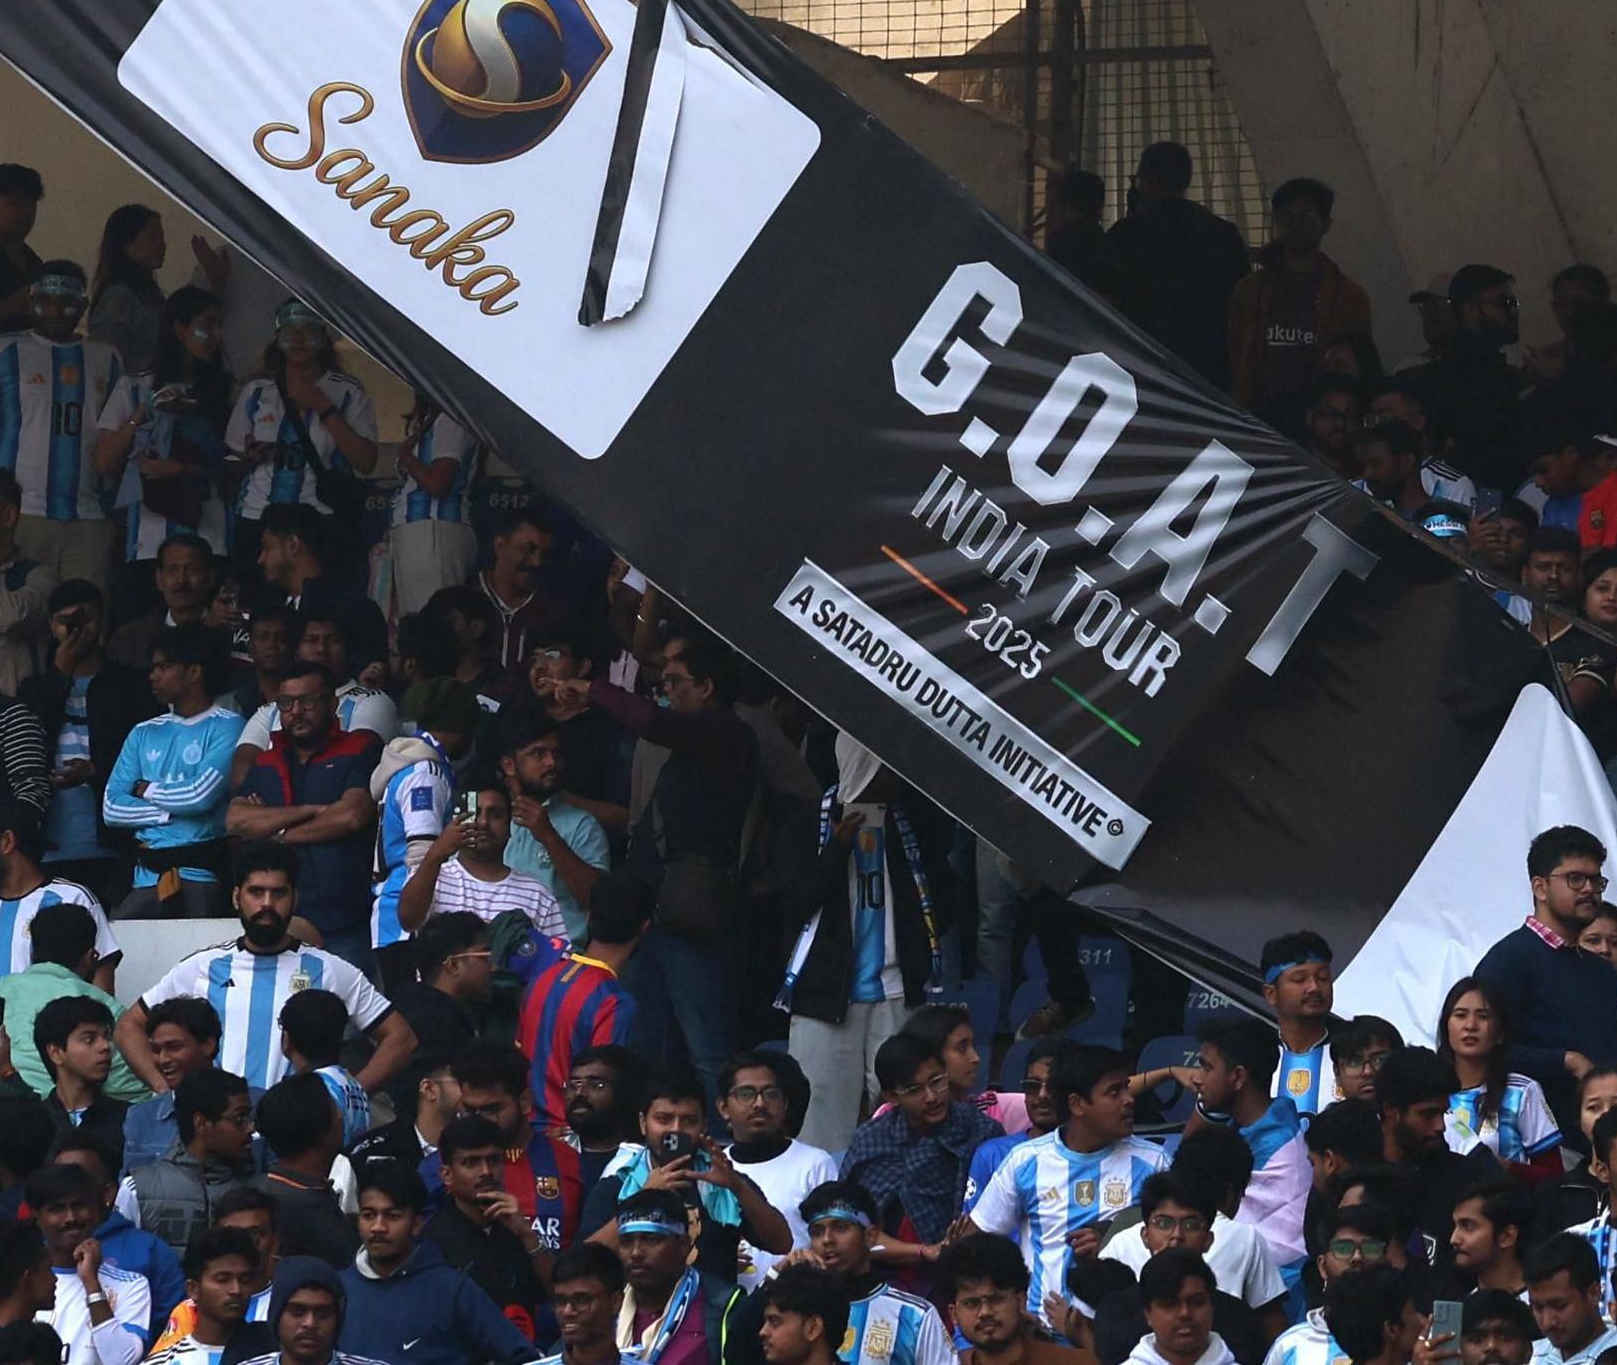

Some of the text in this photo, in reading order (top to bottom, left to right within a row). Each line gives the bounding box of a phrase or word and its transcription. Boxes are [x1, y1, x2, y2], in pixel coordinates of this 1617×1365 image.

[252, 81, 521, 316] Sanaka
[51, 401, 82, 437] 10
[891, 260, 1381, 677] G.O.A.T
[364, 495, 388, 512] 65
[488, 492, 530, 511] 6512
[911, 464, 1181, 698] INDIA TOUR
[788, 584, 815, 615] A
[811, 598, 923, 692] SATADRU
[914, 676, 992, 752] DUTTA
[964, 602, 1052, 680] 2025
[857, 870, 885, 911] 10
[1078, 949, 1113, 966] 311
